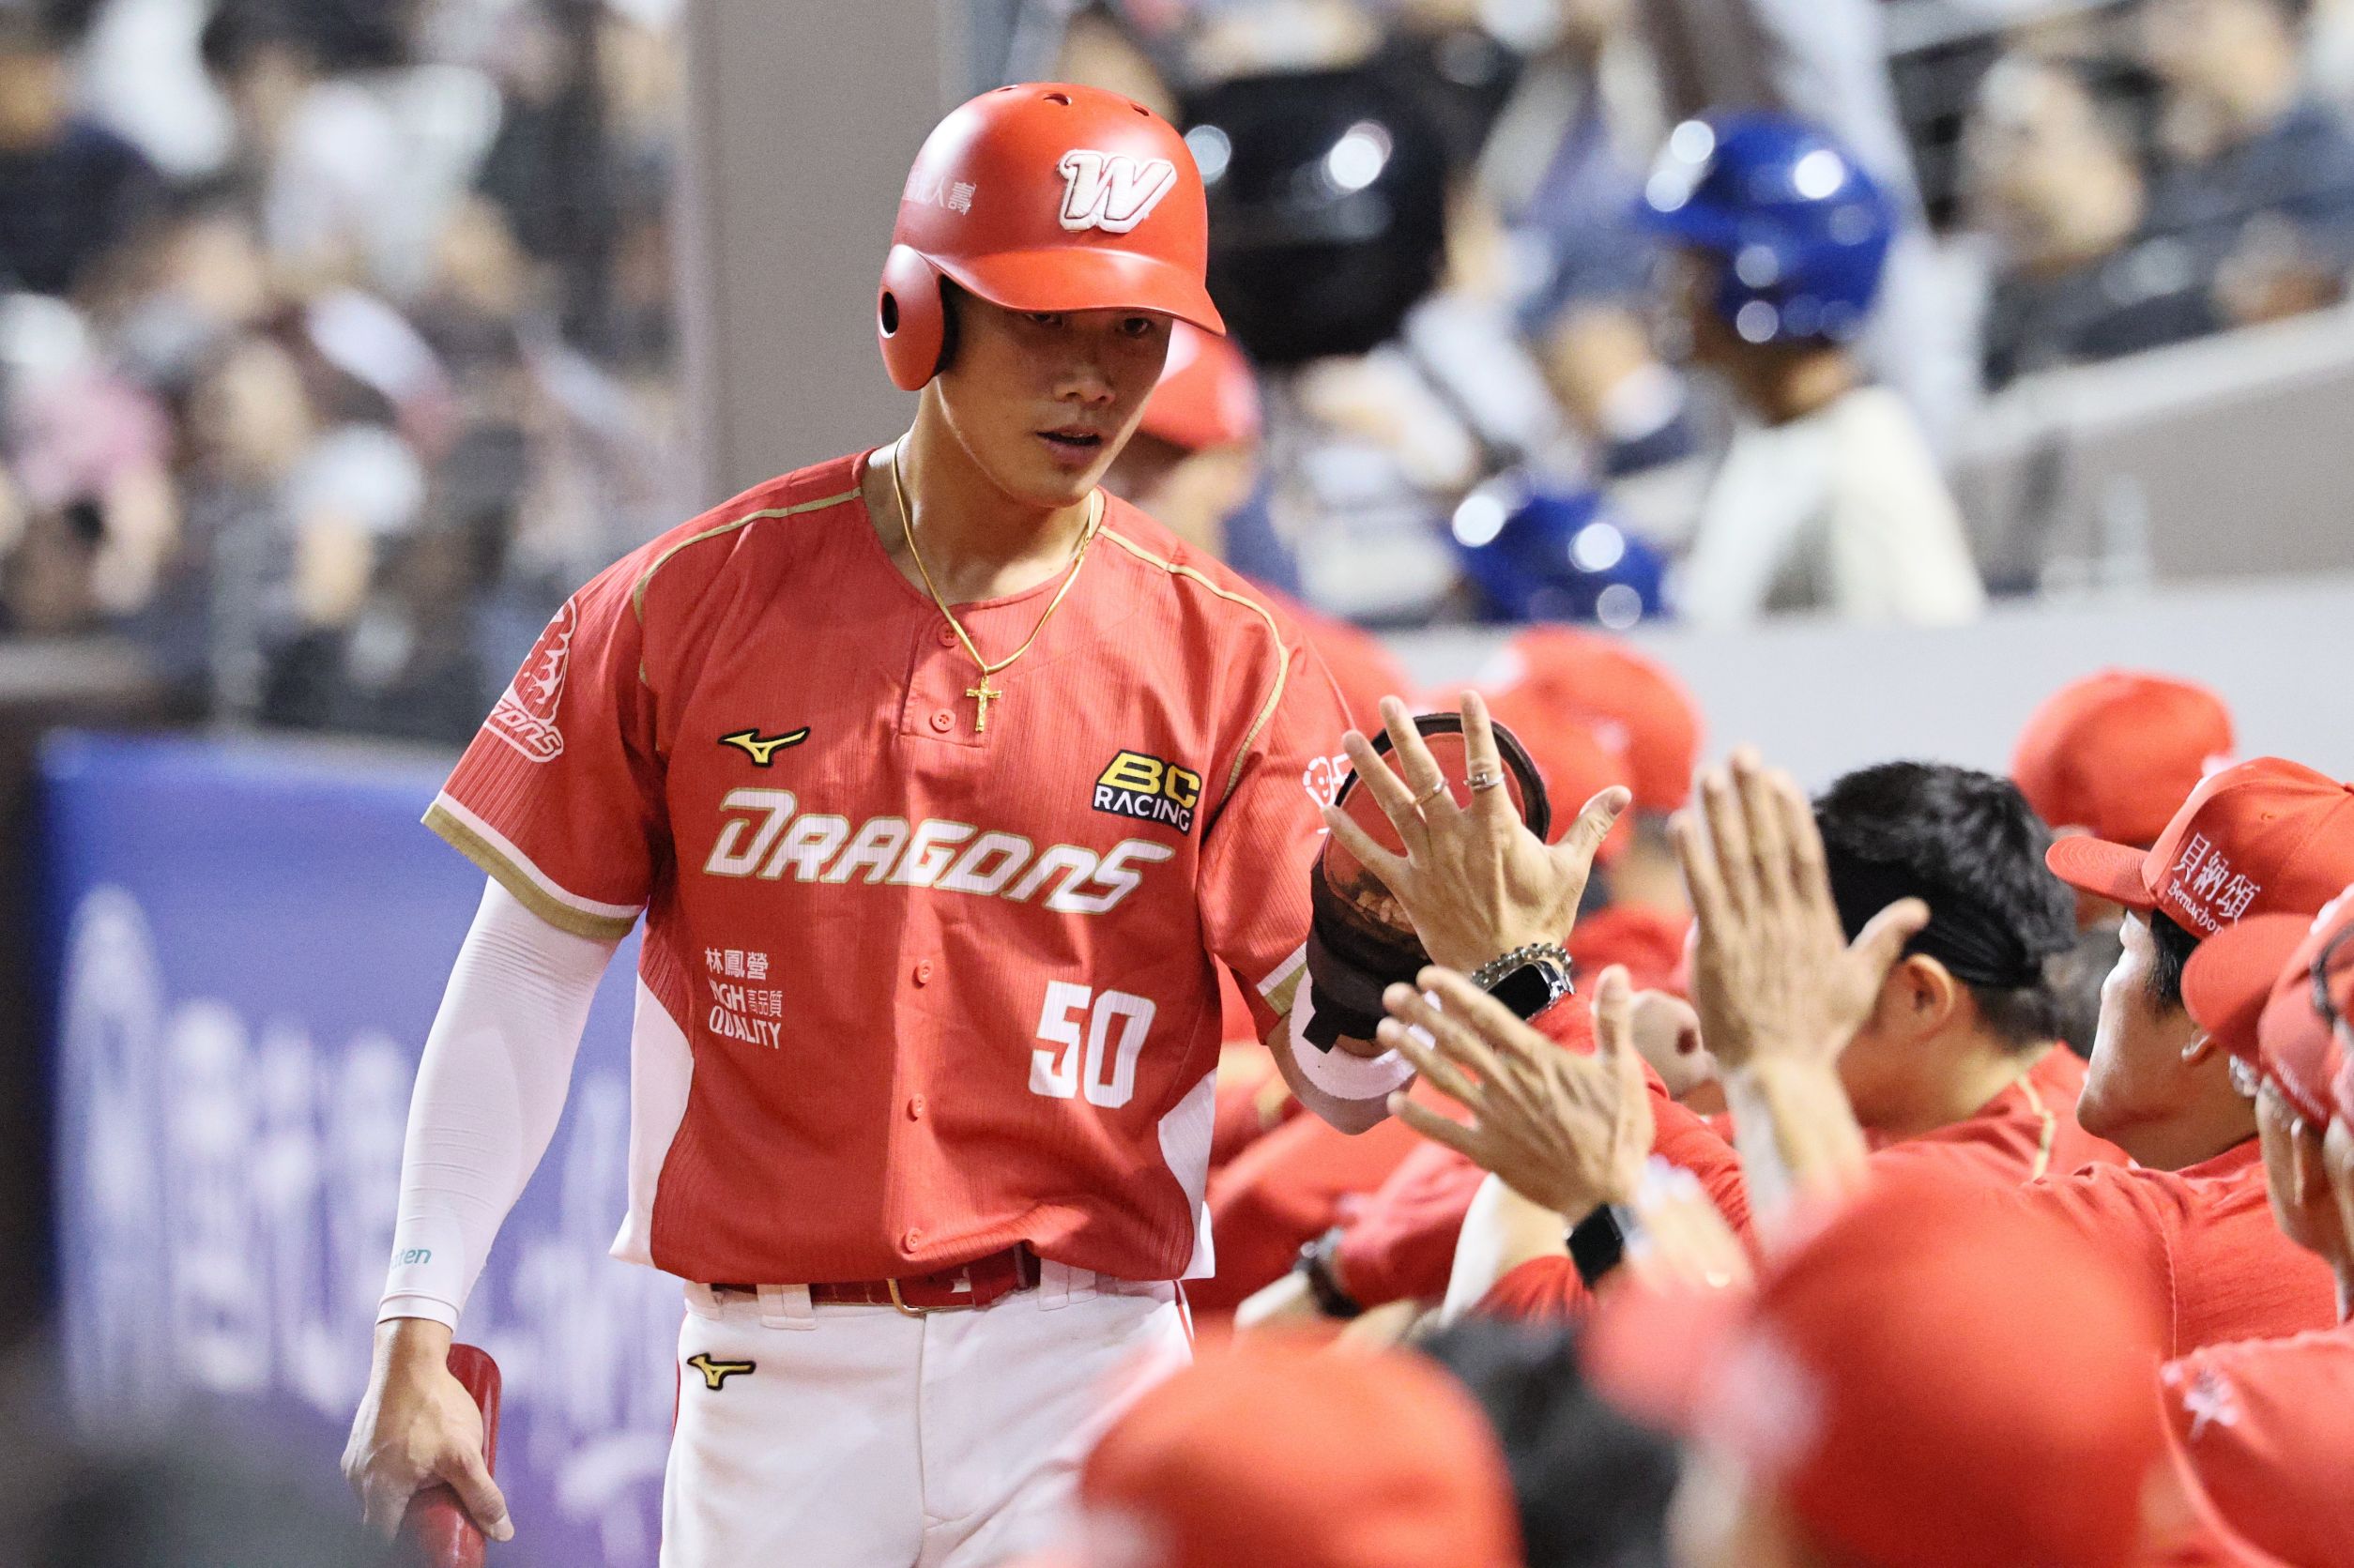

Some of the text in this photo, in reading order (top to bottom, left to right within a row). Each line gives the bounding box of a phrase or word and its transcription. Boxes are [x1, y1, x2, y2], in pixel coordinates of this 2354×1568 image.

[1057, 148, 1178, 234] W
[1098, 752, 1200, 809] BC
[1093, 784, 1191, 832] RACING
[2172, 831, 2262, 927] 貝納頌
[705, 947, 769, 981] 林鳳營
[709, 1005, 782, 1050] QUALITY
[747, 988, 783, 1018] 高品質
[1028, 979, 1157, 1109] 50
